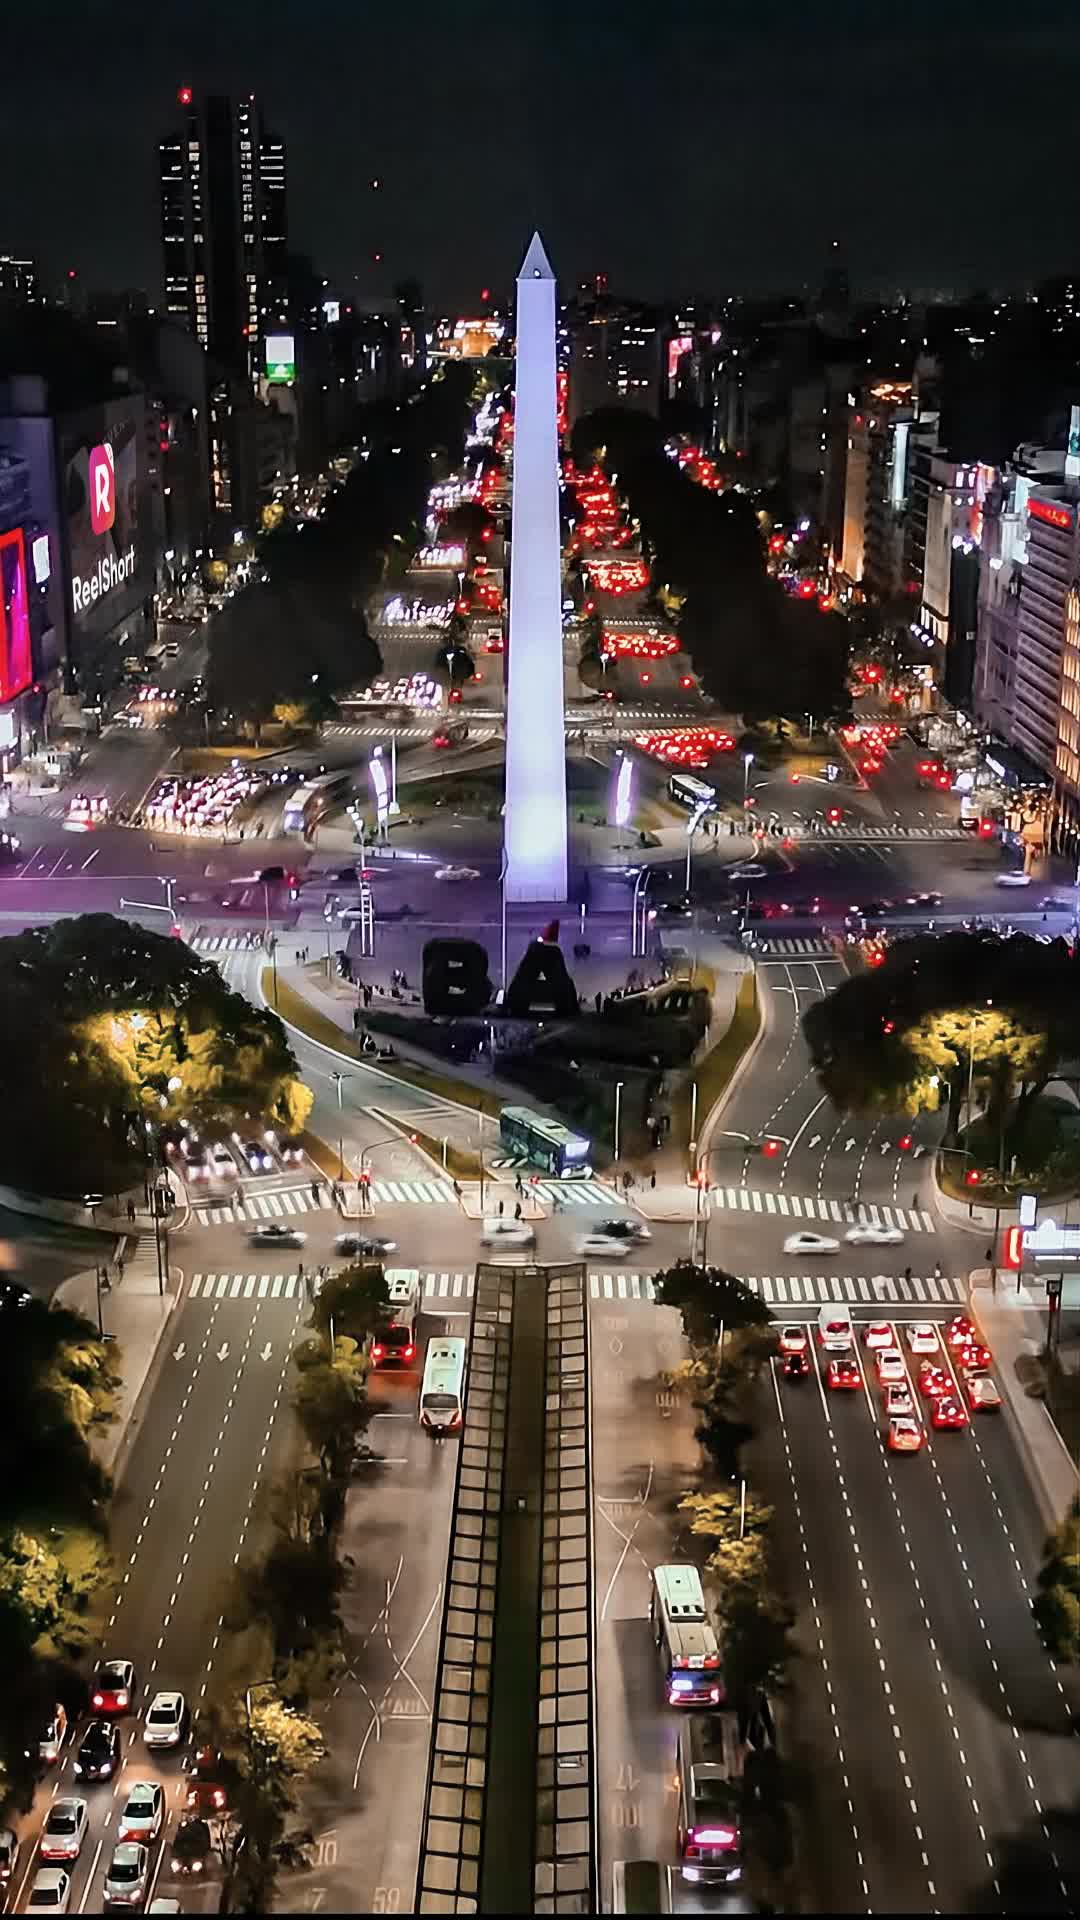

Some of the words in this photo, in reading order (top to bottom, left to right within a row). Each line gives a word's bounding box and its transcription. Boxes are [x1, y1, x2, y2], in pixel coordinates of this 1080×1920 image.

[95, 463, 111, 518] R
[72, 544, 135, 614] ReelShort
[423, 937, 577, 1016] BA
